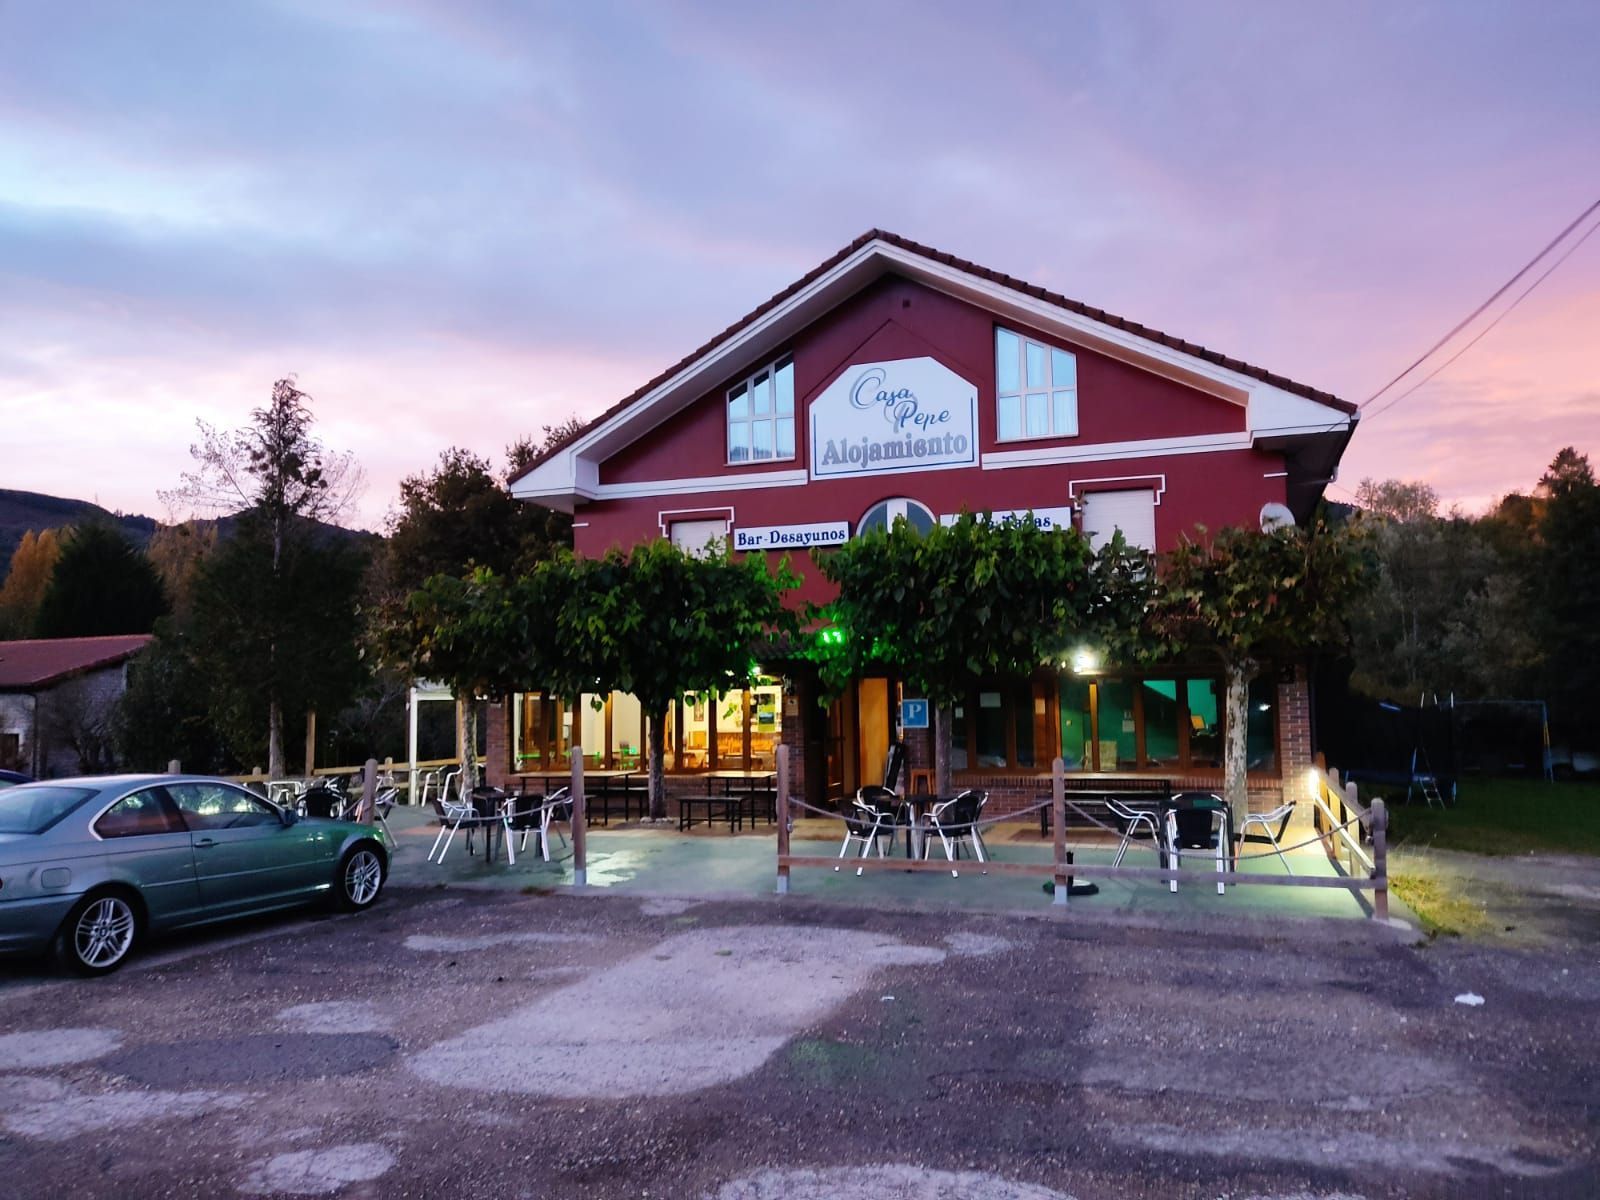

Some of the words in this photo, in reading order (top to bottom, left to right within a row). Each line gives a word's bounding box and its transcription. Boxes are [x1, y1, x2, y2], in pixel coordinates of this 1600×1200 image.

[850, 367, 912, 409] Casa
[885, 396, 950, 433] Pepe
[821, 431, 968, 469] Alojamiento
[909, 703, 922, 719] P
